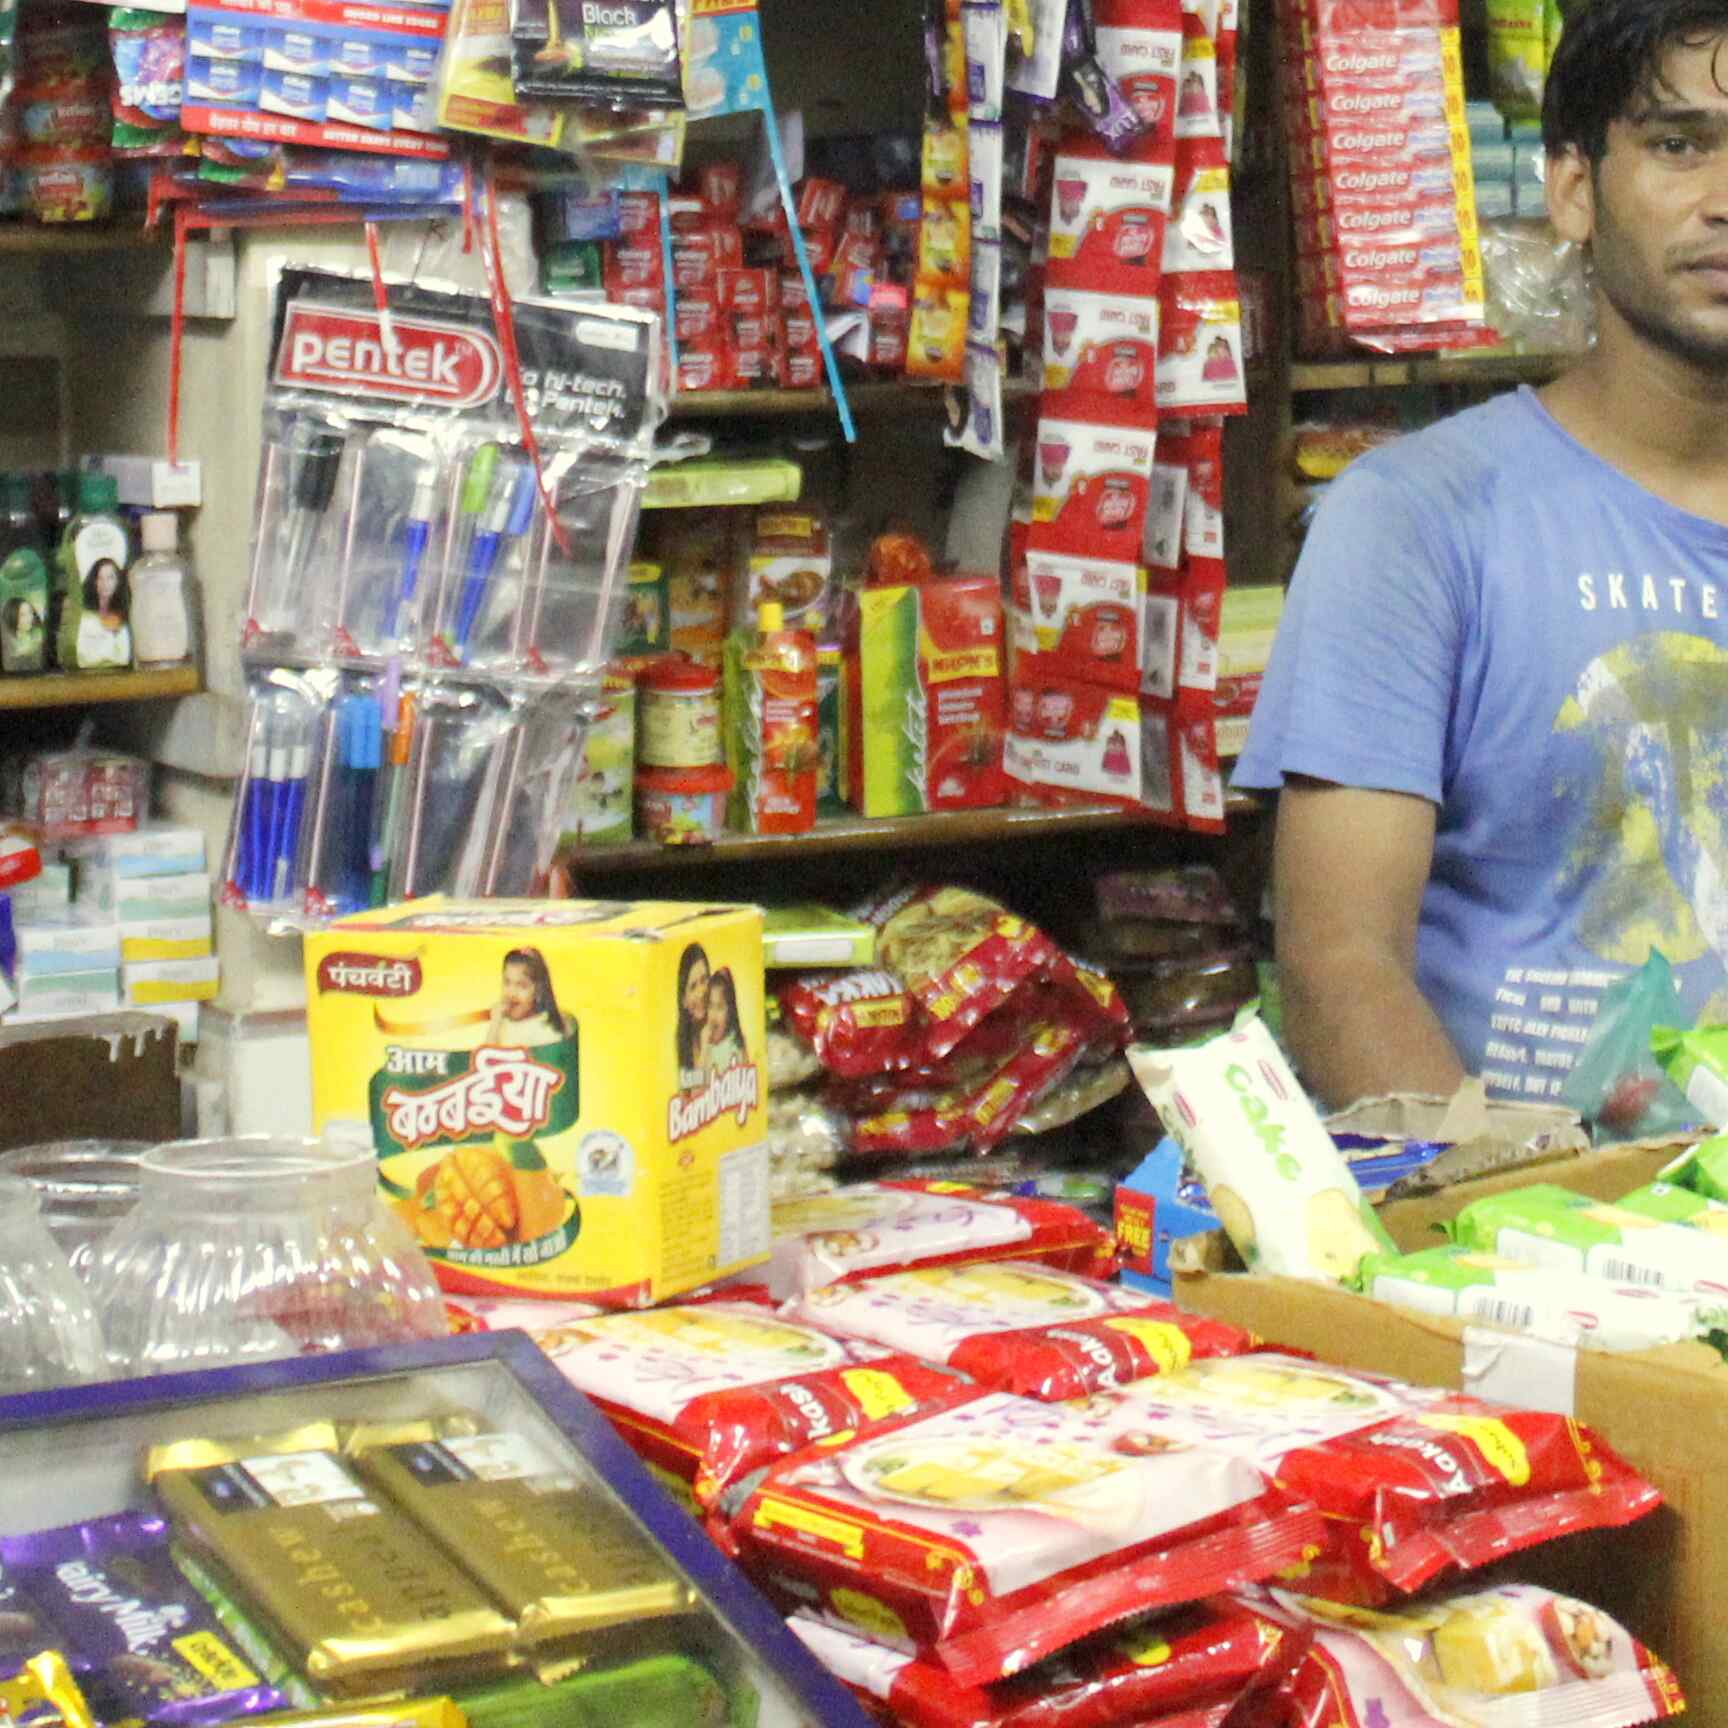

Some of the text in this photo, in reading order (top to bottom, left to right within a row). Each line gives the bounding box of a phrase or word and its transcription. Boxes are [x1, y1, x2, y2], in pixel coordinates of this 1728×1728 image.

[1326, 52, 1398, 73] Colgate
[1330, 92, 1401, 113] Colgate
[1333, 131, 1405, 152] Colgate
[1336, 171, 1407, 191] Colgate
[1340, 209, 1412, 232] Colgate
[1345, 248, 1417, 270] Colgate
[290, 329, 460, 385] pentek
[1578, 574, 1719, 618] SKATE
[387, 1045, 449, 1074] आम
[670, 1065, 758, 1142] Bambaiya
